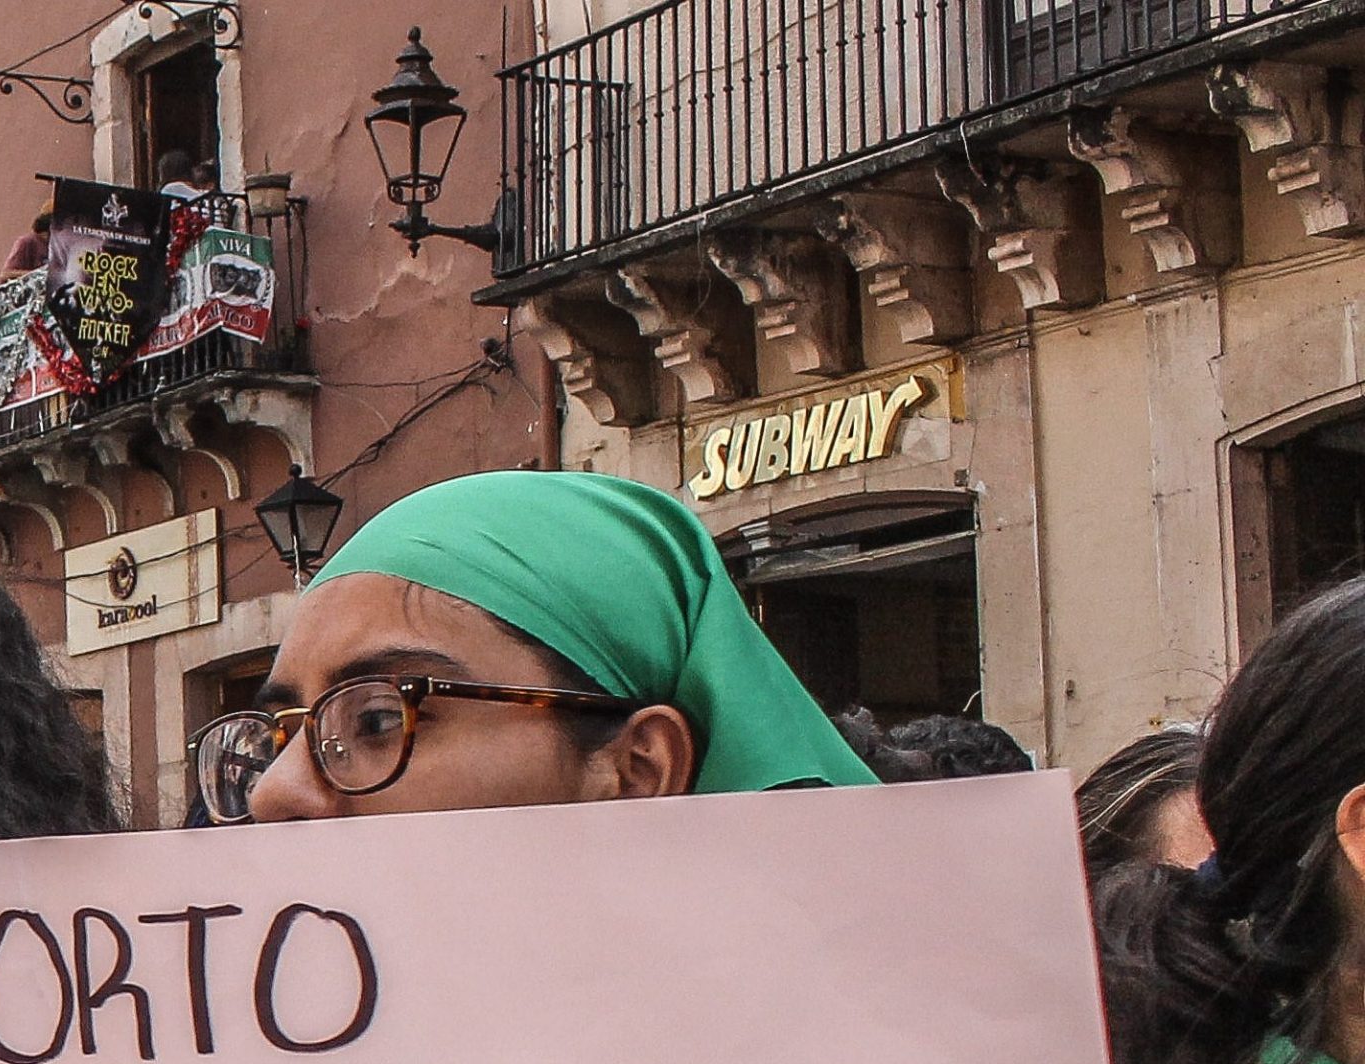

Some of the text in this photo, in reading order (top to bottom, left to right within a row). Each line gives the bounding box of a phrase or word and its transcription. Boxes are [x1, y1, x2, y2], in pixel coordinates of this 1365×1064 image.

[219, 238, 251, 256] VIVA
[83, 249, 138, 281] ROCK
[77, 284, 127, 314] VIVO
[93, 271, 121, 297] EN
[77, 317, 131, 348] ROCKER
[688, 374, 923, 501] SUBWAY
